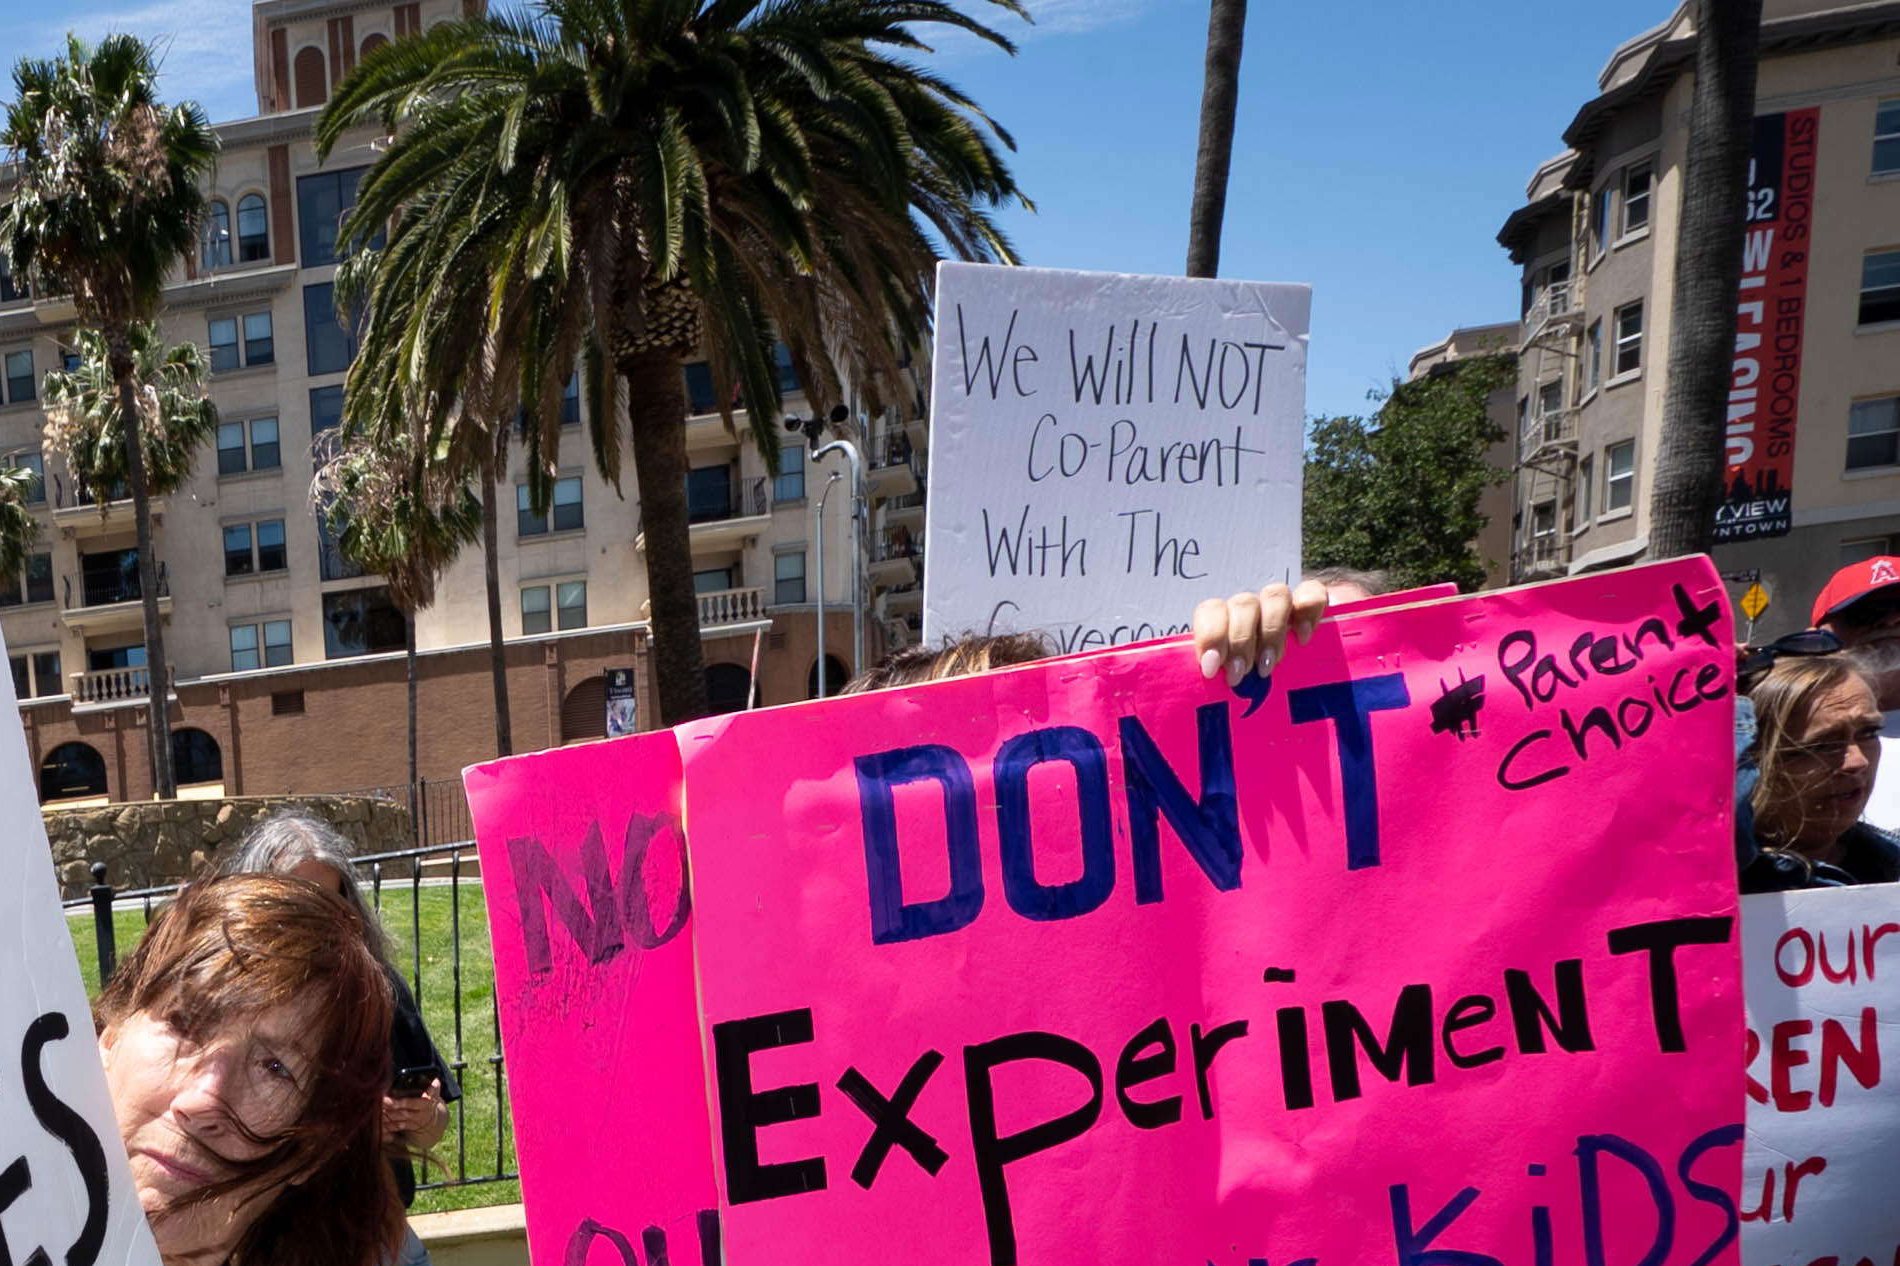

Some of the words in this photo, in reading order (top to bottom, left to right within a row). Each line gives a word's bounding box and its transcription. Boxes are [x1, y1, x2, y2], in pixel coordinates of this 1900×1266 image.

[1784, 117, 1816, 242] STUDIOS
[957, 303, 1038, 400] We
[1069, 319, 1158, 405] Will
[1174, 332, 1286, 415] NOT
[1766, 295, 1801, 459] BEDROOMS
[1028, 413, 1267, 487] Co-Parent
[981, 504, 1087, 578] With
[1118, 508, 1209, 580] The
[1712, 519, 1787, 537] NTOWN
[854, 672, 1411, 946] DON'T
[506, 811, 692, 977] NO
